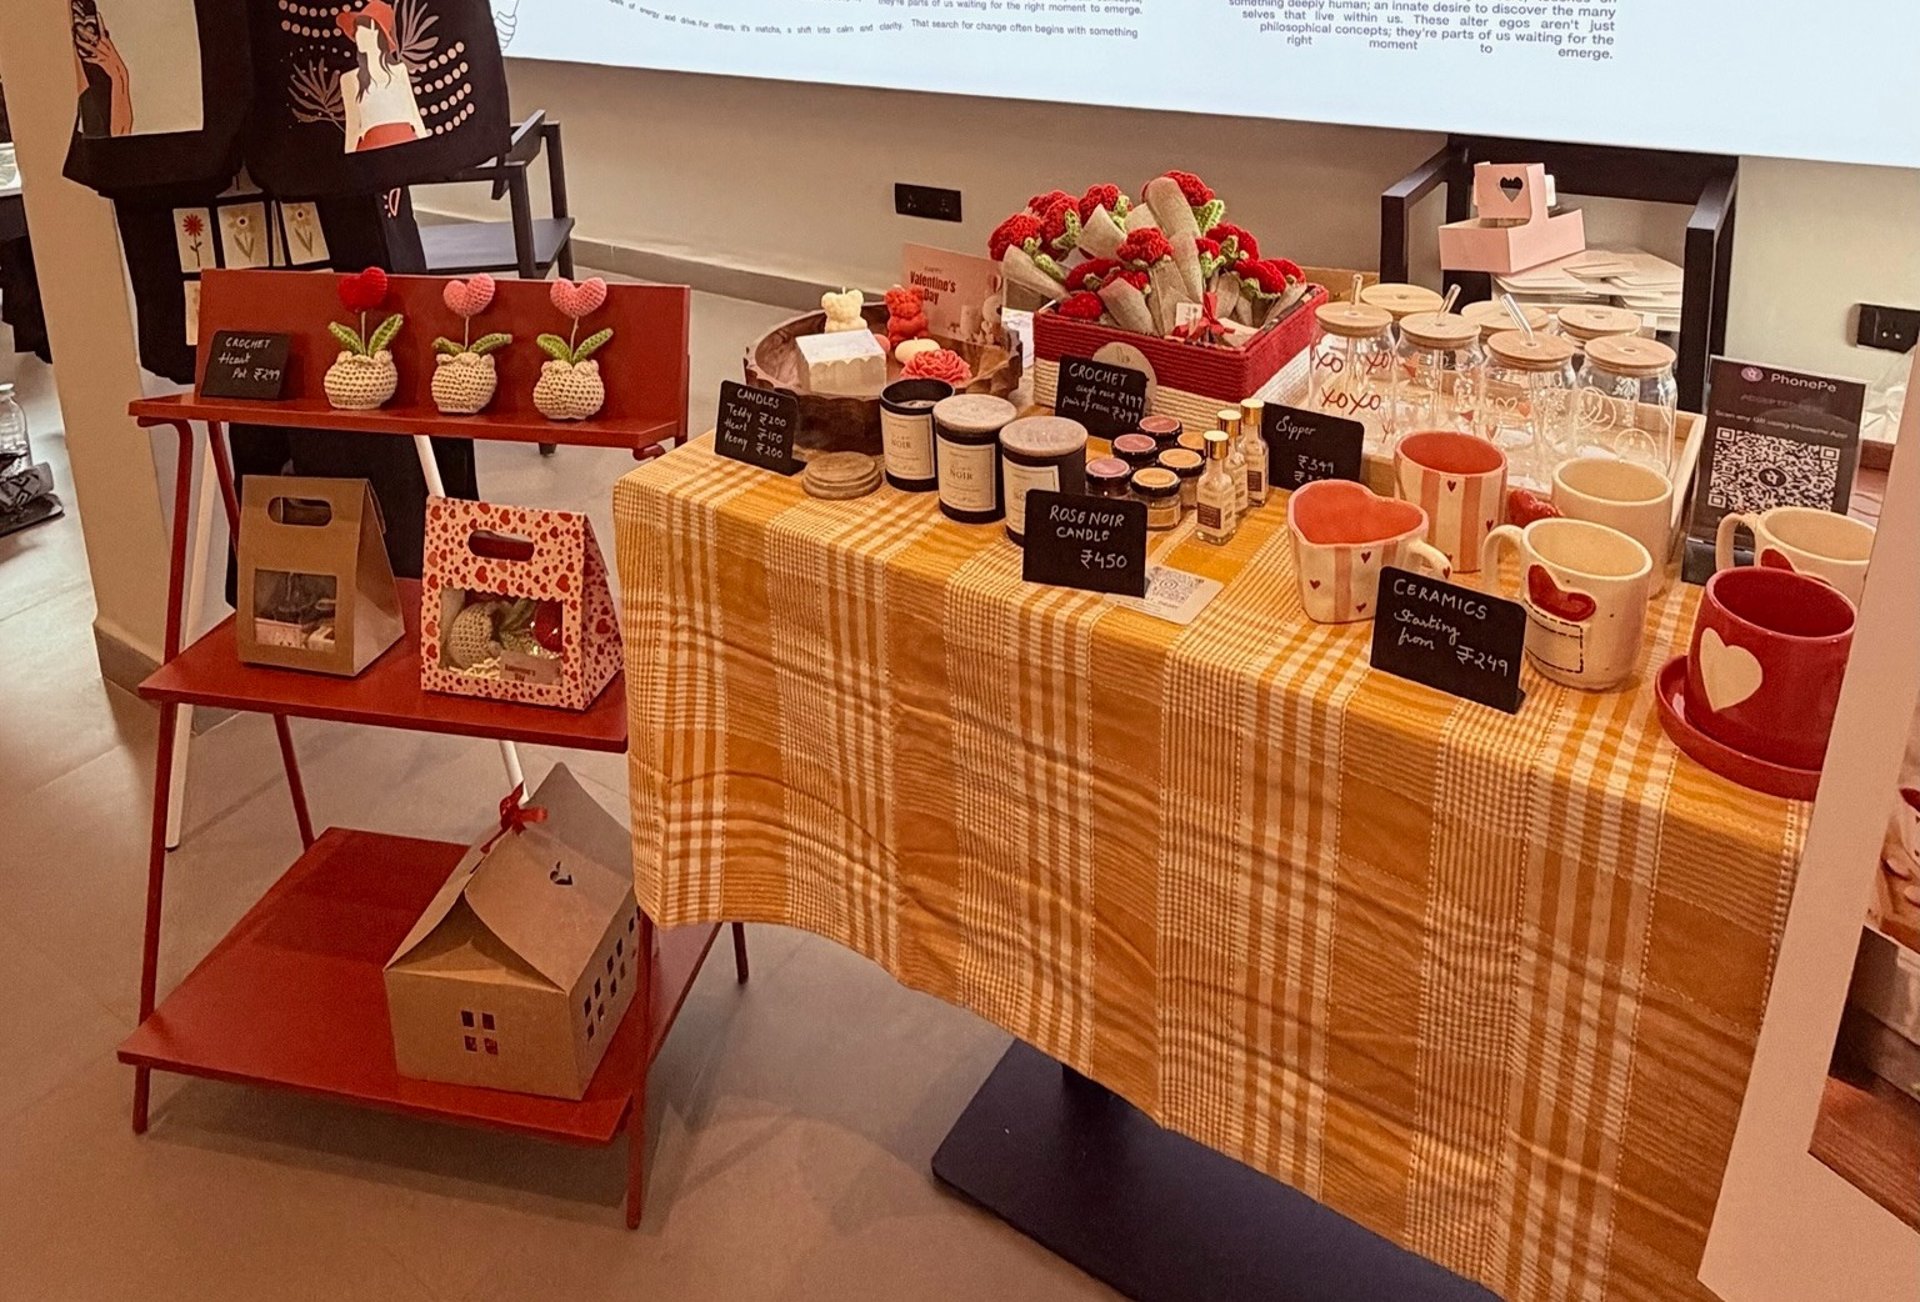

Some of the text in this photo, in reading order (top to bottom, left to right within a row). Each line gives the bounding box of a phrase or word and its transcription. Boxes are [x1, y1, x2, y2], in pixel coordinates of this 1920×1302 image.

[957, 0, 987, 11] waiting
[990, 1, 1002, 9] for
[1007, 2, 1020, 10] the
[1025, 3, 1044, 13] right
[1049, 4, 1086, 13] moment
[1091, 4, 1100, 13] to
[1104, 5, 1143, 16] emerge.
[1229, 0, 1616, 20] something deeply human; an innate desire to discover the many
[797, 26, 812, 34] shift
[818, 26, 831, 34] into
[836, 25, 854, 33] calm
[860, 24, 873, 32] and
[911, 19, 1138, 39] That search for change often begins with something
[1242, 9, 1615, 33] selves that live within us. These alter egos aren't just
[1259, 22, 1614, 46] philosophical concepts; they're parts of us waiting for the
[1287, 35, 1613, 61] right moment to emerge.
[910, 271, 956, 293] Valentine's
[923, 288, 939, 305] Day
[225, 336, 271, 349] CROCHET
[1069, 362, 1128, 387] CROCHET
[1771, 373, 1837, 393] PhonePe
[737, 388, 780, 409] CANDLES
[727, 402, 787, 428] Teddy ₹200
[724, 418, 783, 444] Heart ₹150
[1275, 415, 1317, 440] Sipper
[725, 430, 784, 459] Peony ₹200
[1049, 504, 1125, 527] ROSE NOIR
[1056, 526, 1111, 542] CANDLE
[1080, 549, 1128, 569] ₹450
[1393, 578, 1488, 620] CERAMICS
[1393, 608, 1461, 646] Starting
[1398, 626, 1508, 677] from ₹249
